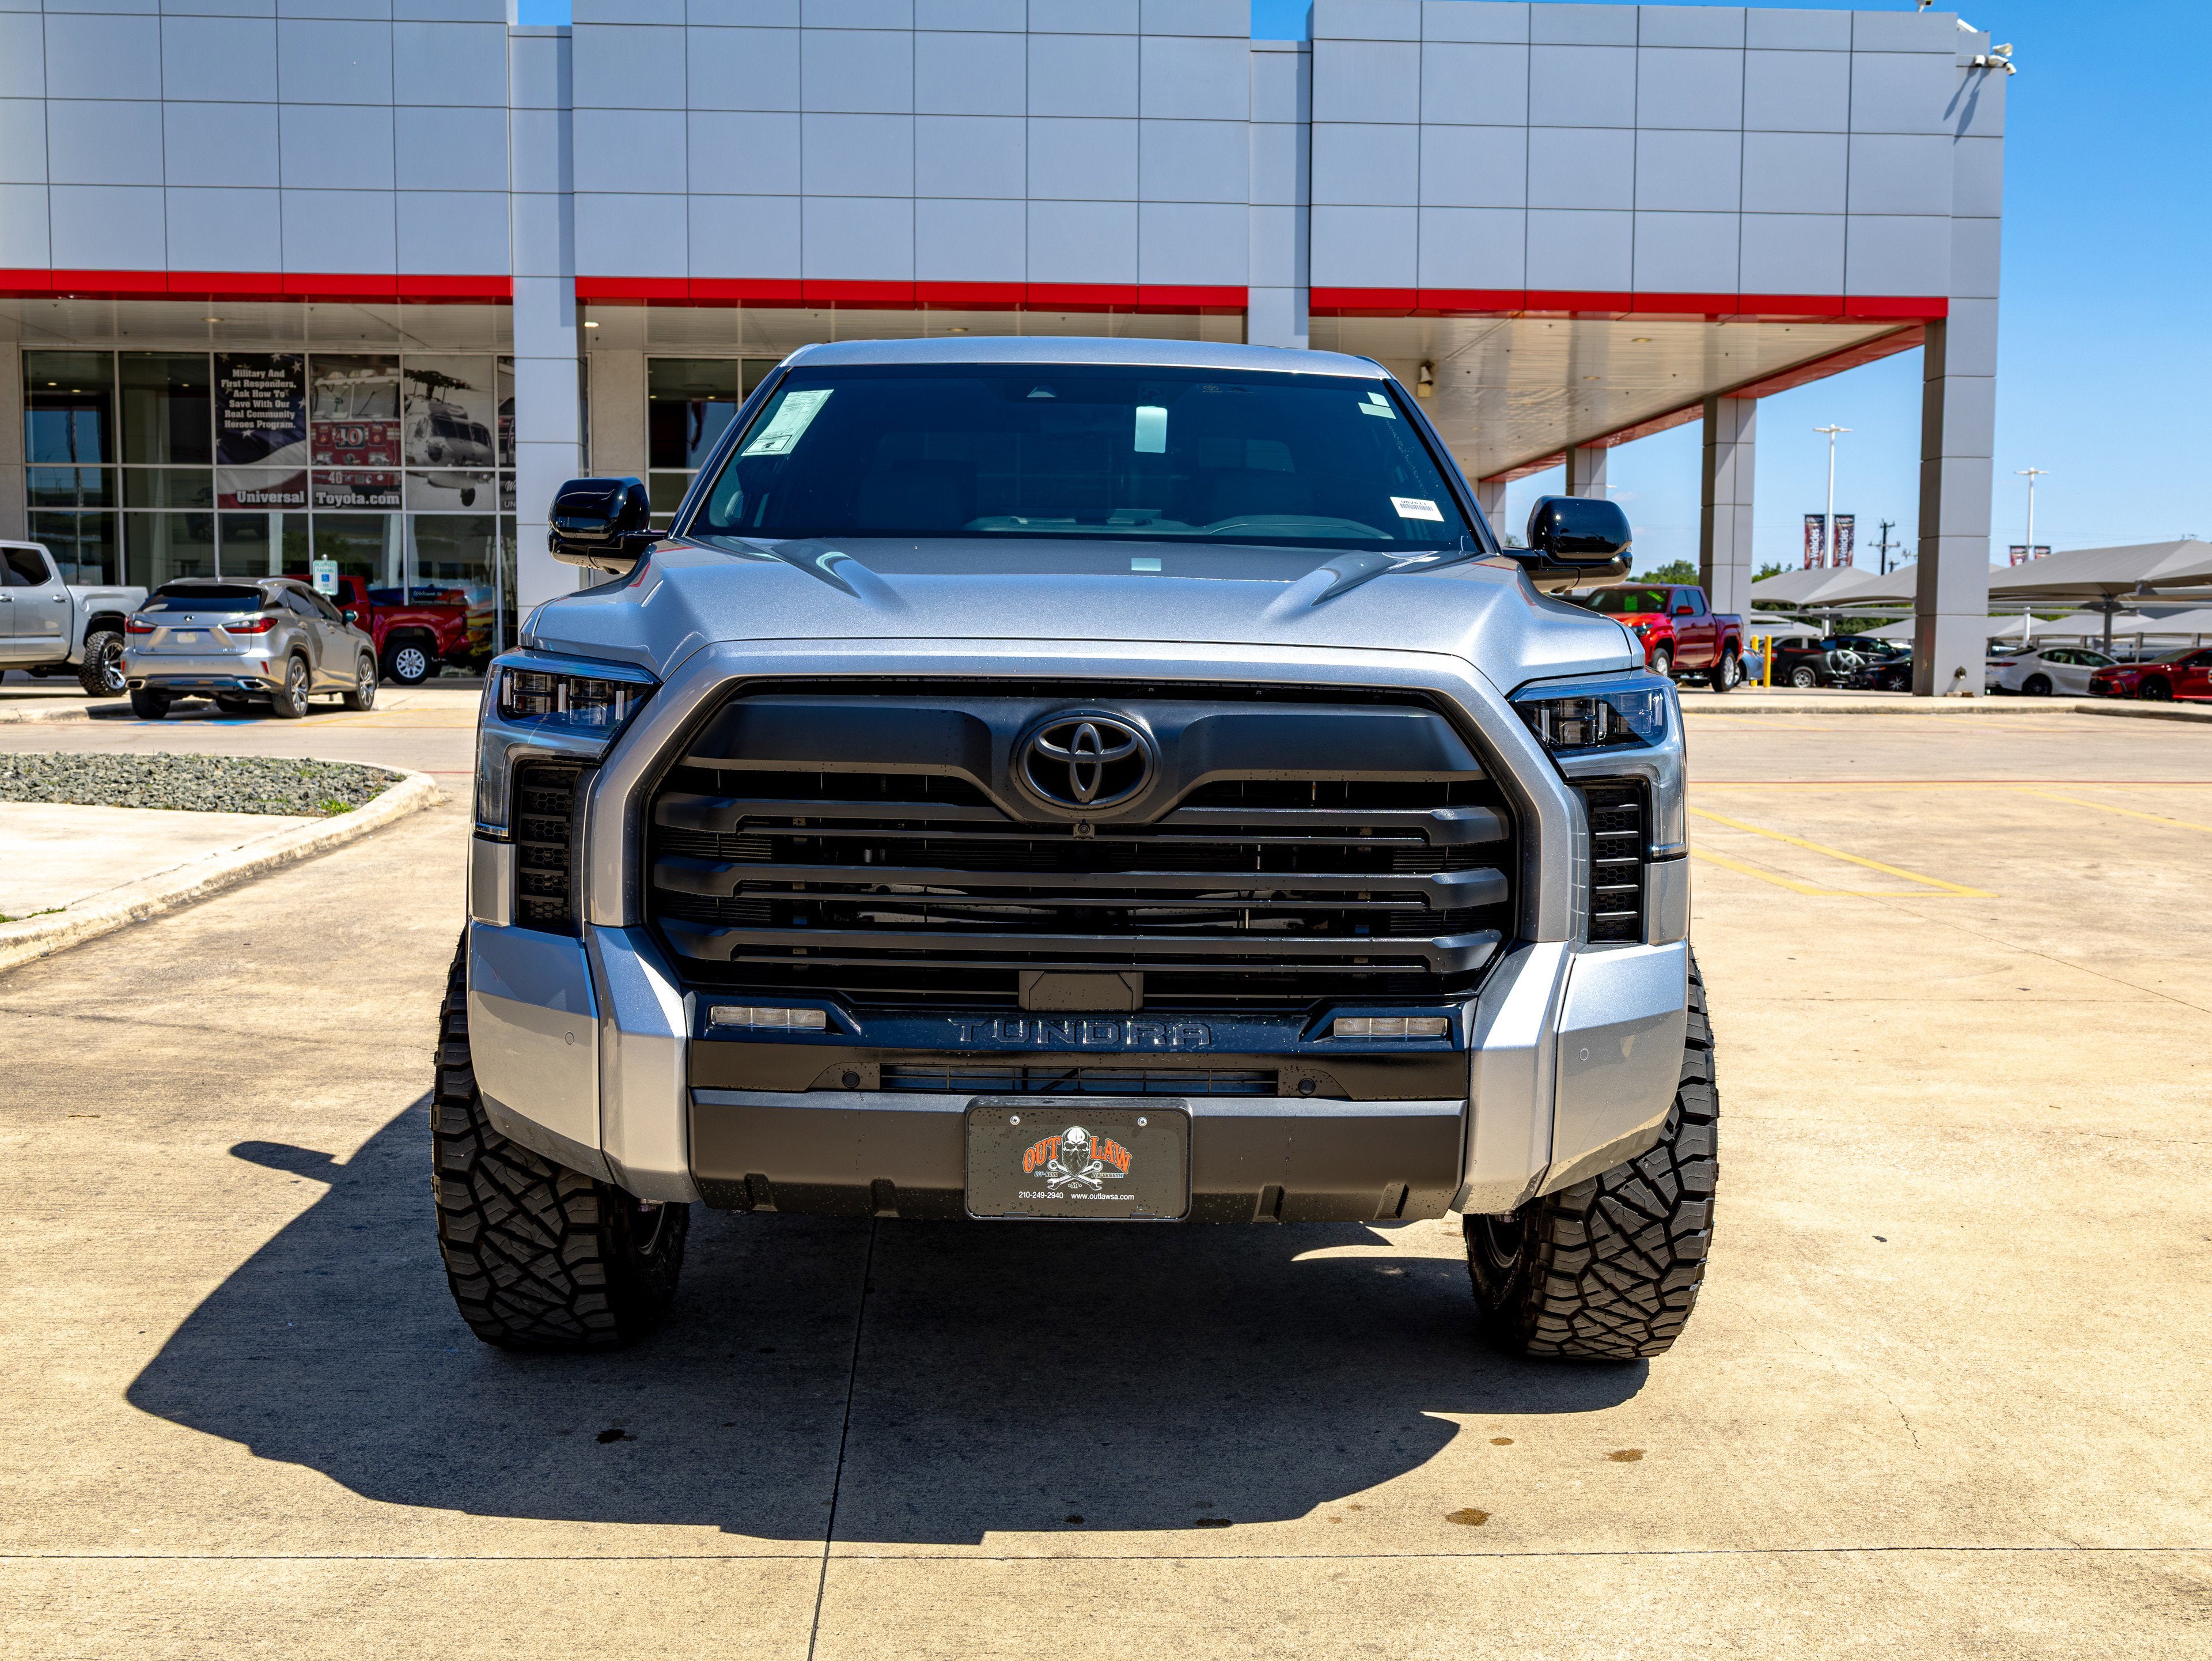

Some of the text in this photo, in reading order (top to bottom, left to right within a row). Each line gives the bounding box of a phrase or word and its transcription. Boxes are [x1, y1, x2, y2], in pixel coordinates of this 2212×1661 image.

[232, 369, 285, 379] Military And
[221, 379, 297, 389] First Responders,
[233, 389, 285, 398] Ask How To
[229, 399, 290, 407] Save With Our
[224, 410, 295, 419] Real Community
[224, 420, 296, 430] Heroes Program.
[333, 427, 363, 446] 40
[328, 471, 343, 484] 40
[236, 490, 400, 507] Universal Toyota.com
[1810, 528, 1820, 559] Vehicles
[1838, 529, 1849, 559] Vehicles
[947, 1018, 1211, 1045] TUNDRA
